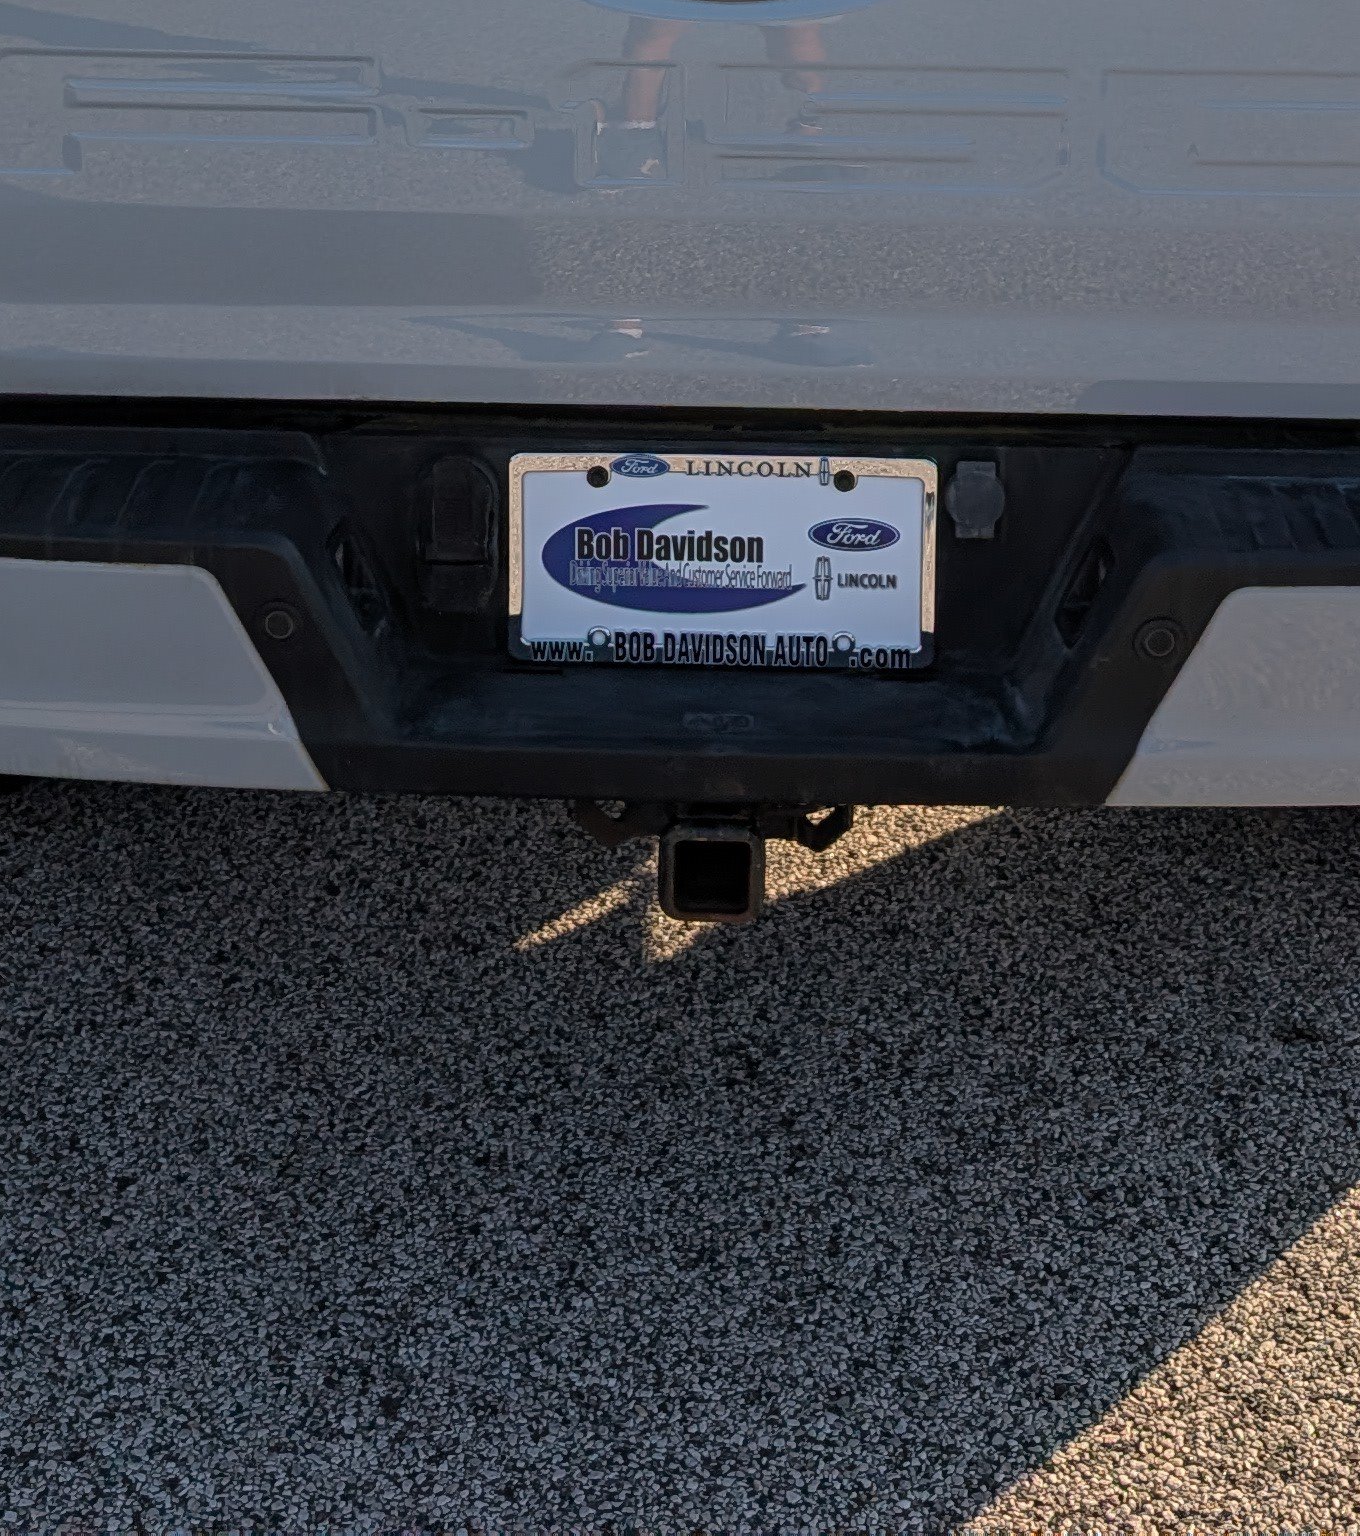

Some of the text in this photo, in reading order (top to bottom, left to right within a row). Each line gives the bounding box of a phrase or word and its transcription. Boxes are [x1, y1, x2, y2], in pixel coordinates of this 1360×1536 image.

[621, 458, 813, 477] Ford LINCOLN
[577, 528, 764, 563] Bob Davidson
[827, 522, 880, 546] Ford
[682, 562, 725, 589] Customer
[725, 563, 756, 589] Service
[756, 563, 792, 590] Forward
[837, 572, 897, 590] LINCOLN
[614, 631, 655, 662] BOB
[663, 632, 767, 665] DAVIDSON
[773, 635, 828, 666] AUTO
